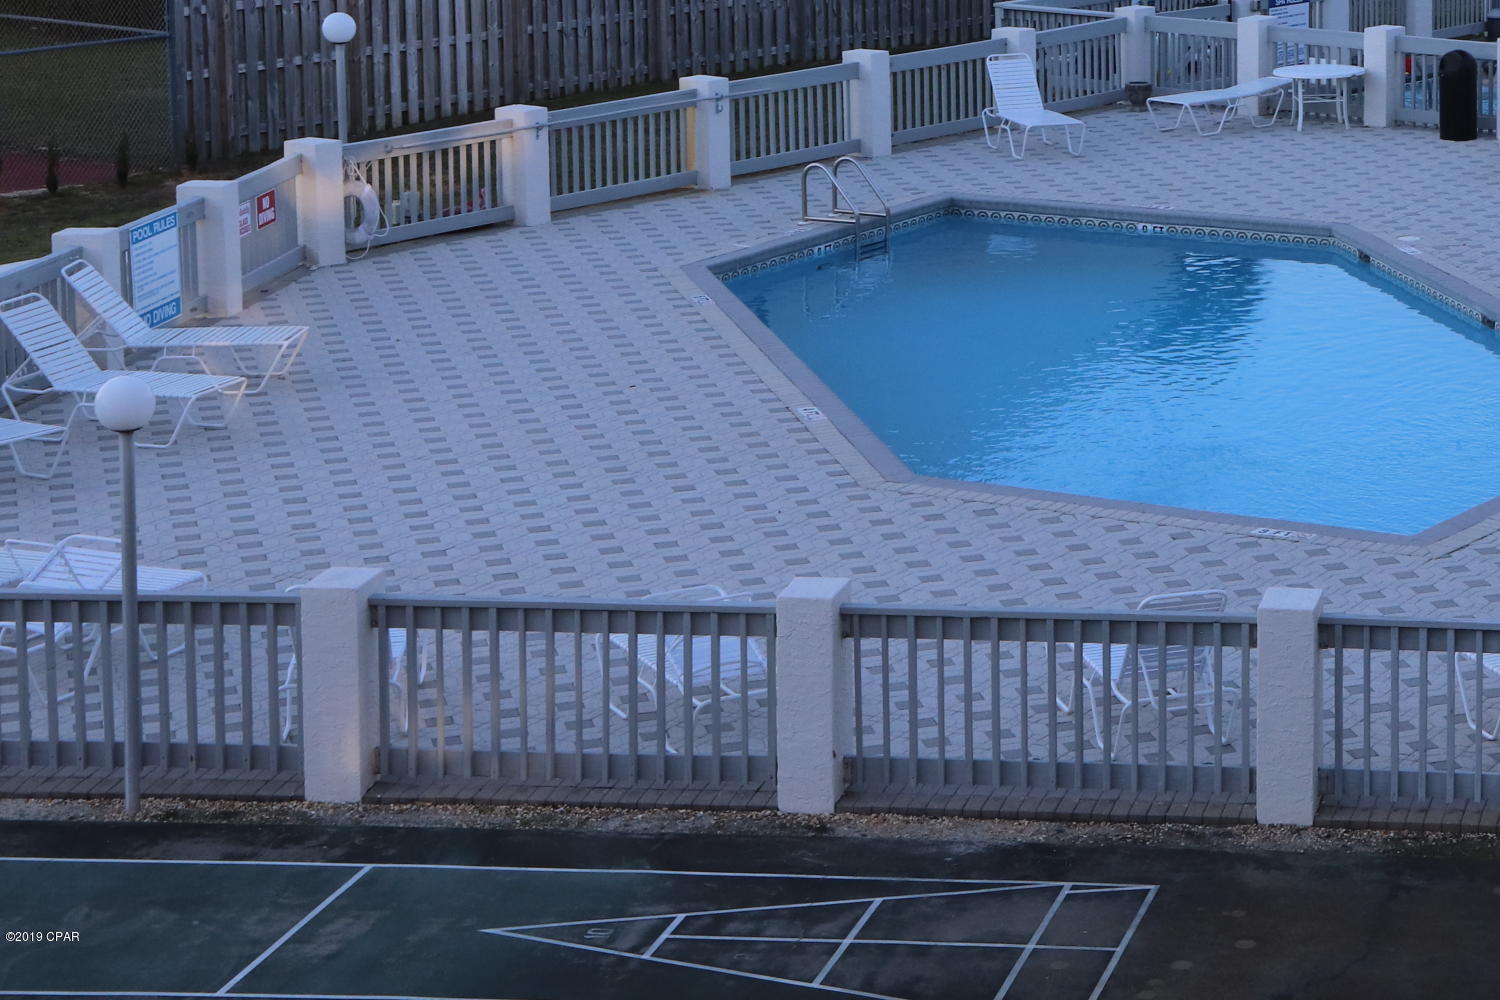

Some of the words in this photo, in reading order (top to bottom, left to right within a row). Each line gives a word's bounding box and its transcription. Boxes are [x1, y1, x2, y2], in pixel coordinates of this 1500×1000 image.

[262, 196, 270, 210] NO
[132, 226, 152, 242] POOL
[153, 215, 176, 231] RULES
[153, 302, 177, 323] DIVING
